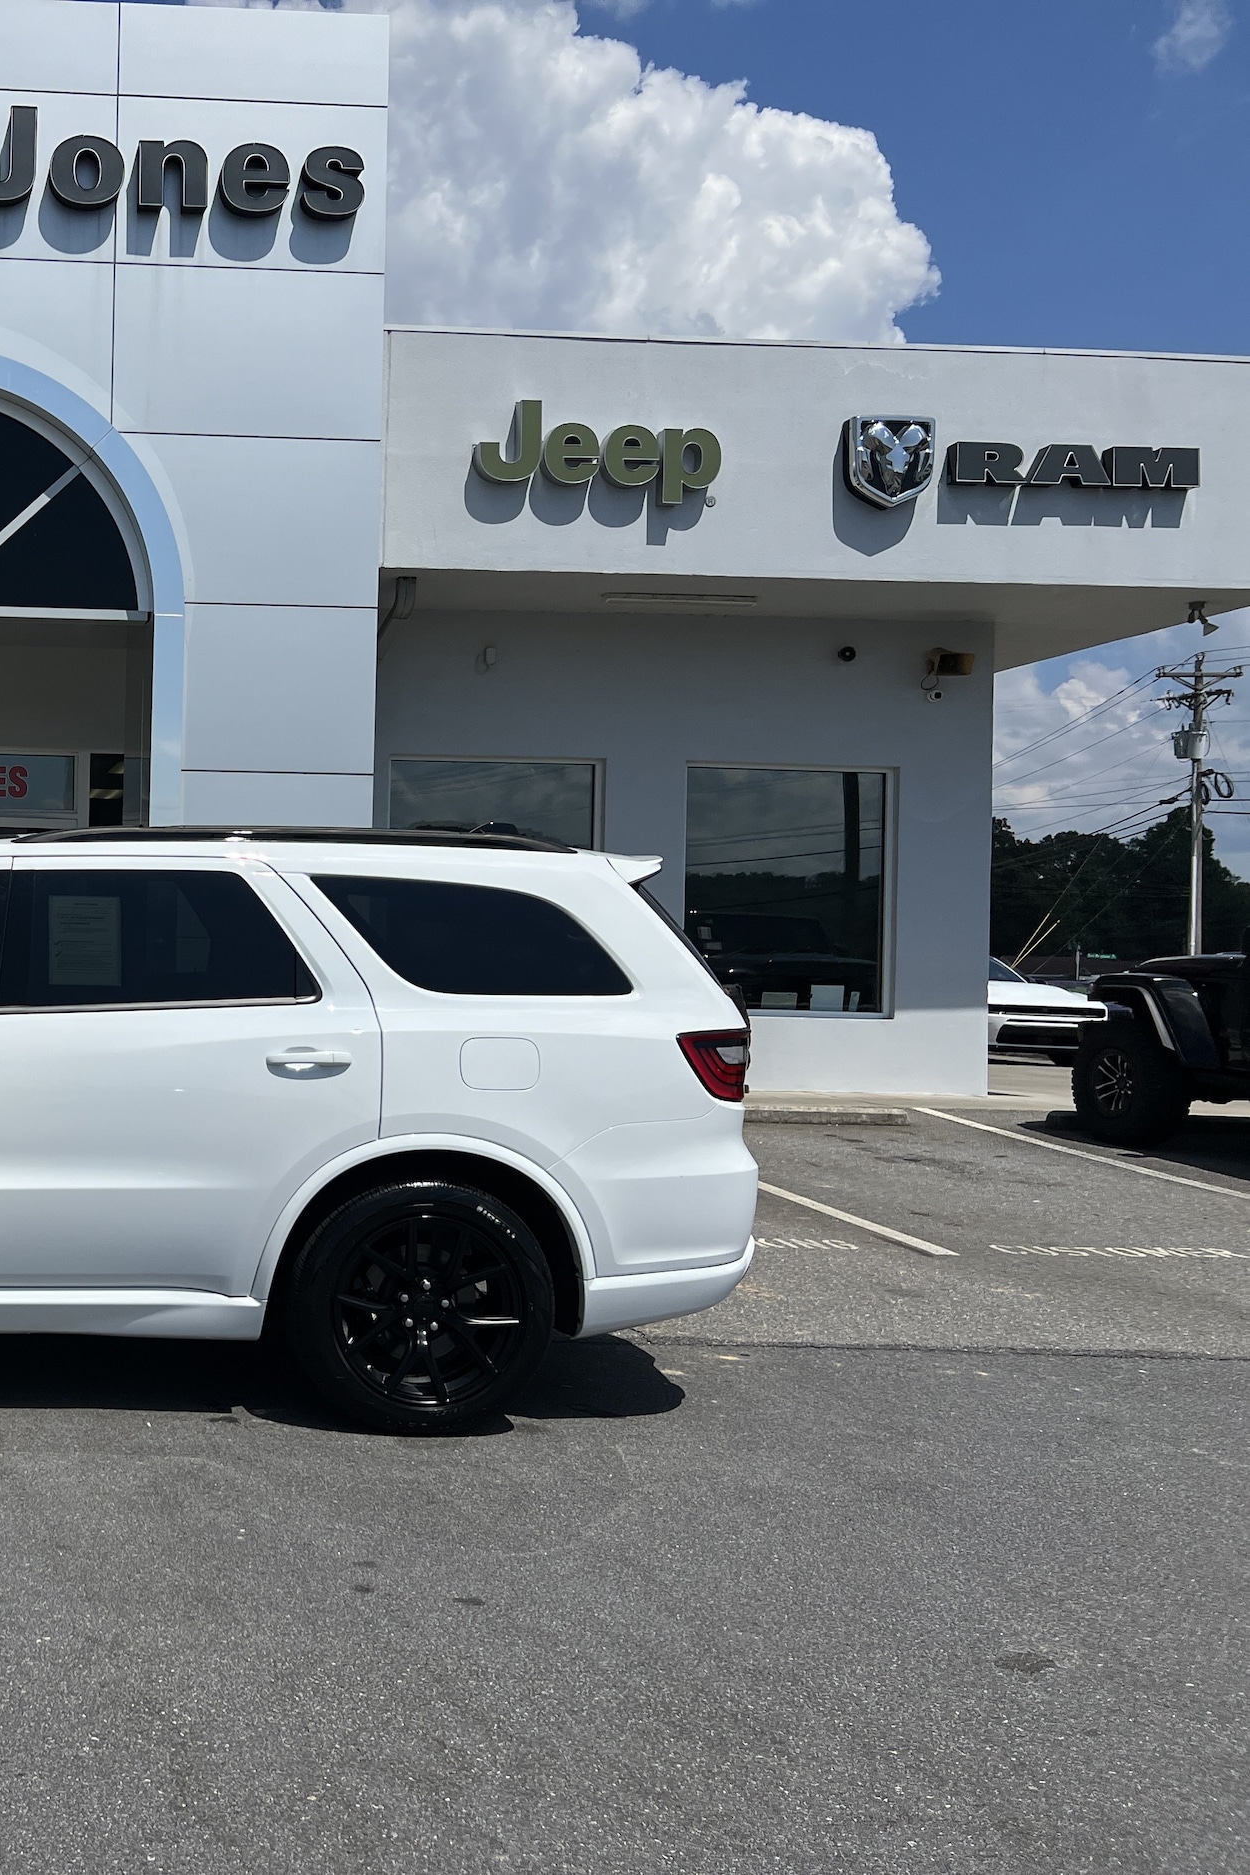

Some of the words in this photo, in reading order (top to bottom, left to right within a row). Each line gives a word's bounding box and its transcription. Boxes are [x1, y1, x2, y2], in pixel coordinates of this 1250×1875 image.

[473, 399, 722, 505] Jeep
[947, 441, 1201, 489] RAM
[988, 1244, 1250, 1259] CUSTOMER
